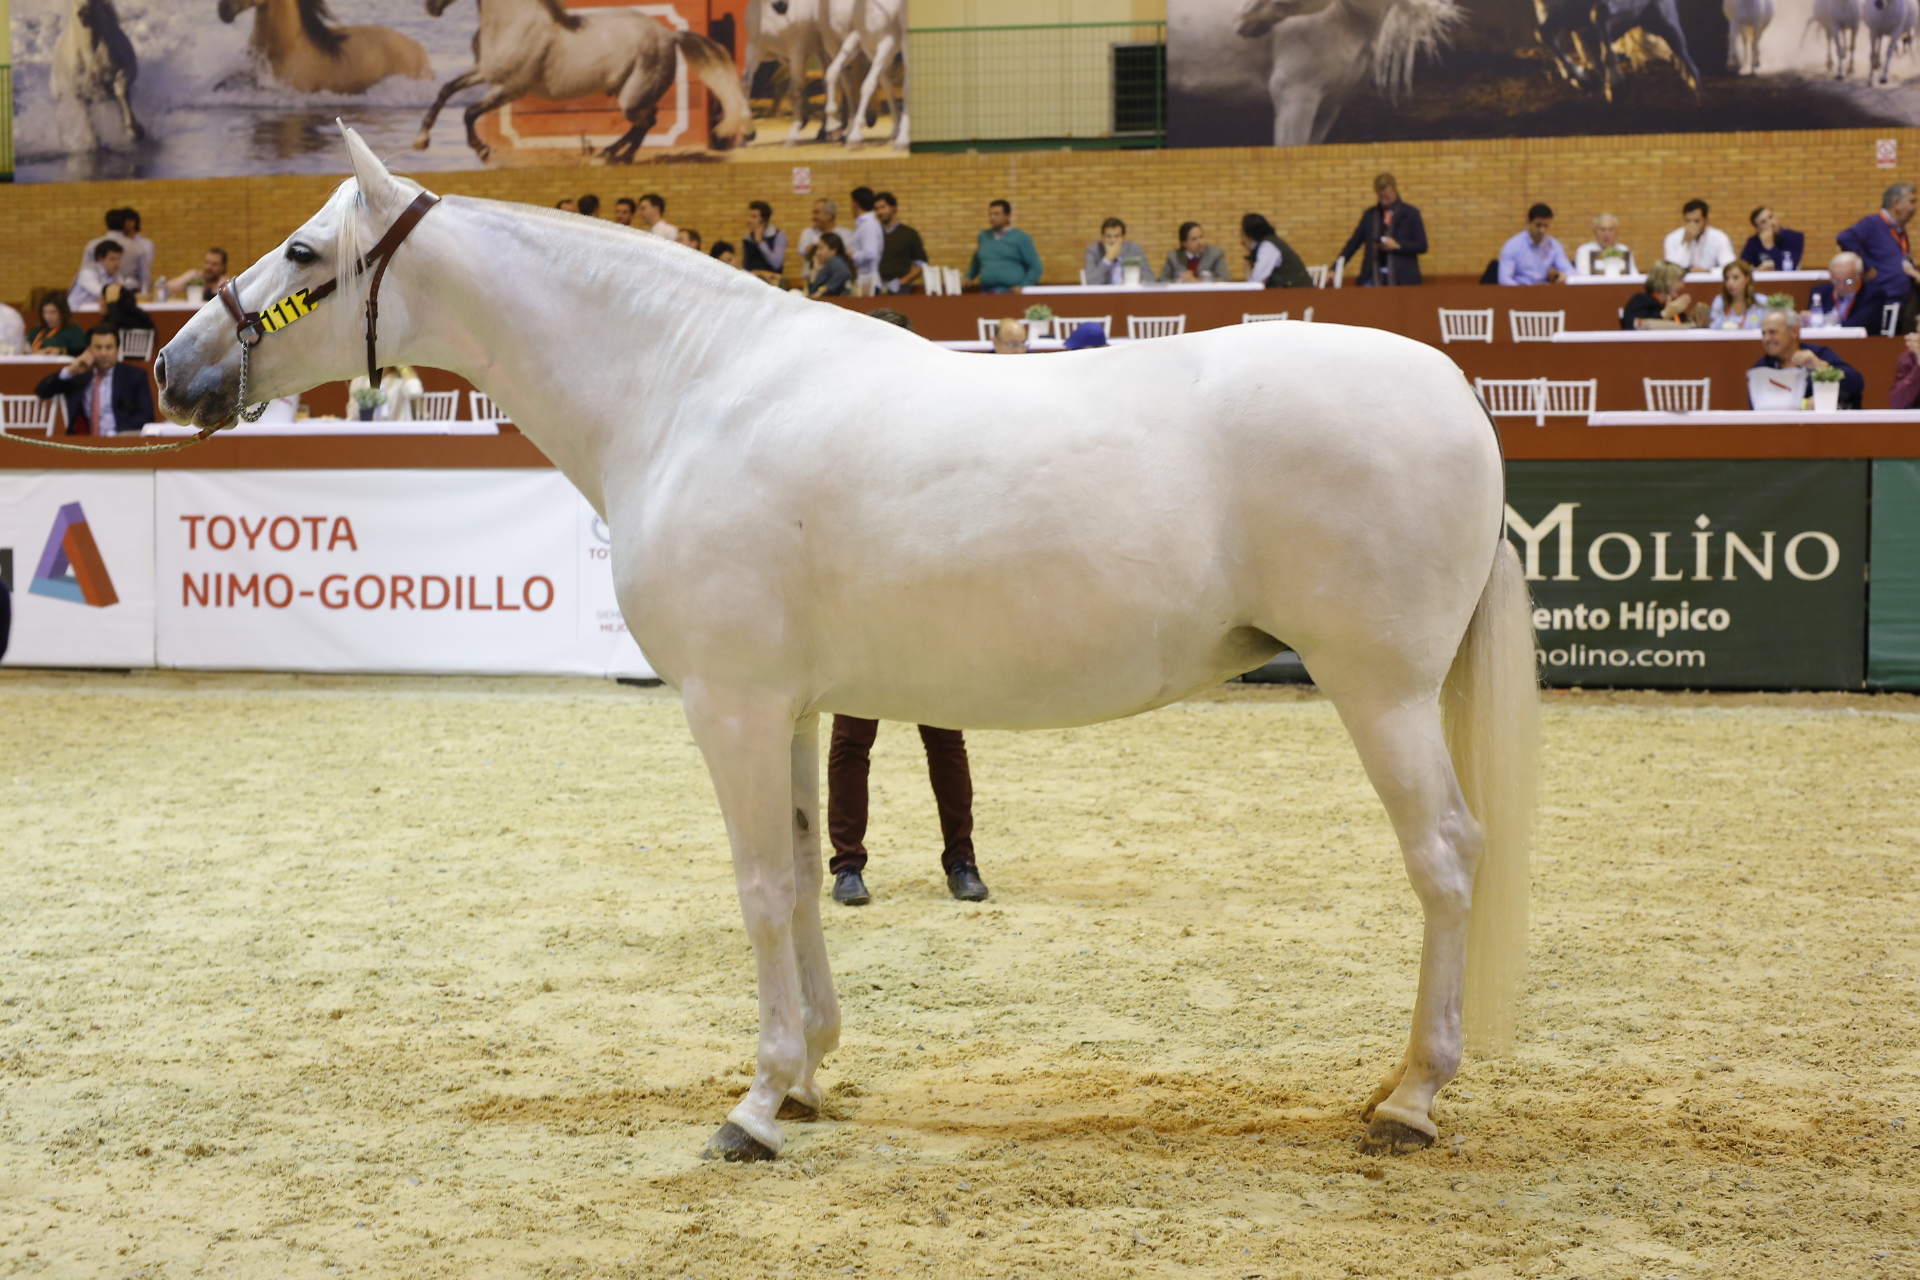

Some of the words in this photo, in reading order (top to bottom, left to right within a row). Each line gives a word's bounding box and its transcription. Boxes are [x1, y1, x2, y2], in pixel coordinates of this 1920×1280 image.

[180, 514, 358, 552] TOYOTA
[181, 572, 555, 612] NIMO-GORDILLO
[1533, 602, 1611, 631] ento
[1619, 600, 1731, 638] Hípico
